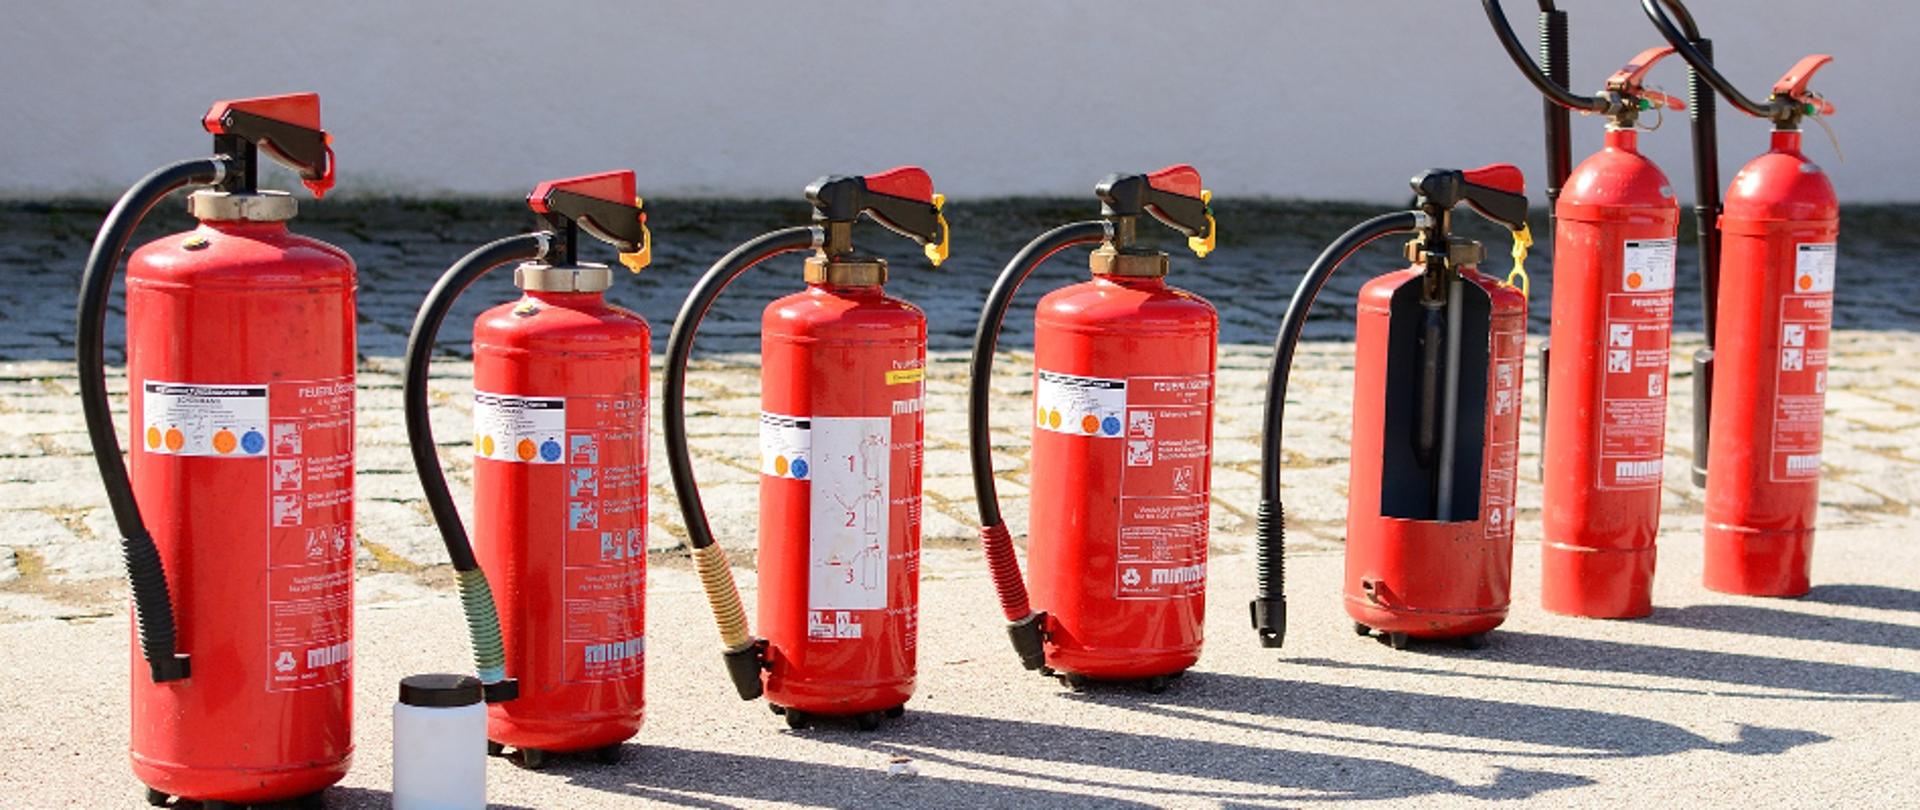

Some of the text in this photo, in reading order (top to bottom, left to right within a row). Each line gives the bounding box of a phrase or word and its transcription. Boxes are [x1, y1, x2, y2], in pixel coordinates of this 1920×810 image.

[848, 455, 855, 472] 1
[845, 511, 856, 527] 2
[845, 568, 854, 584] 3
